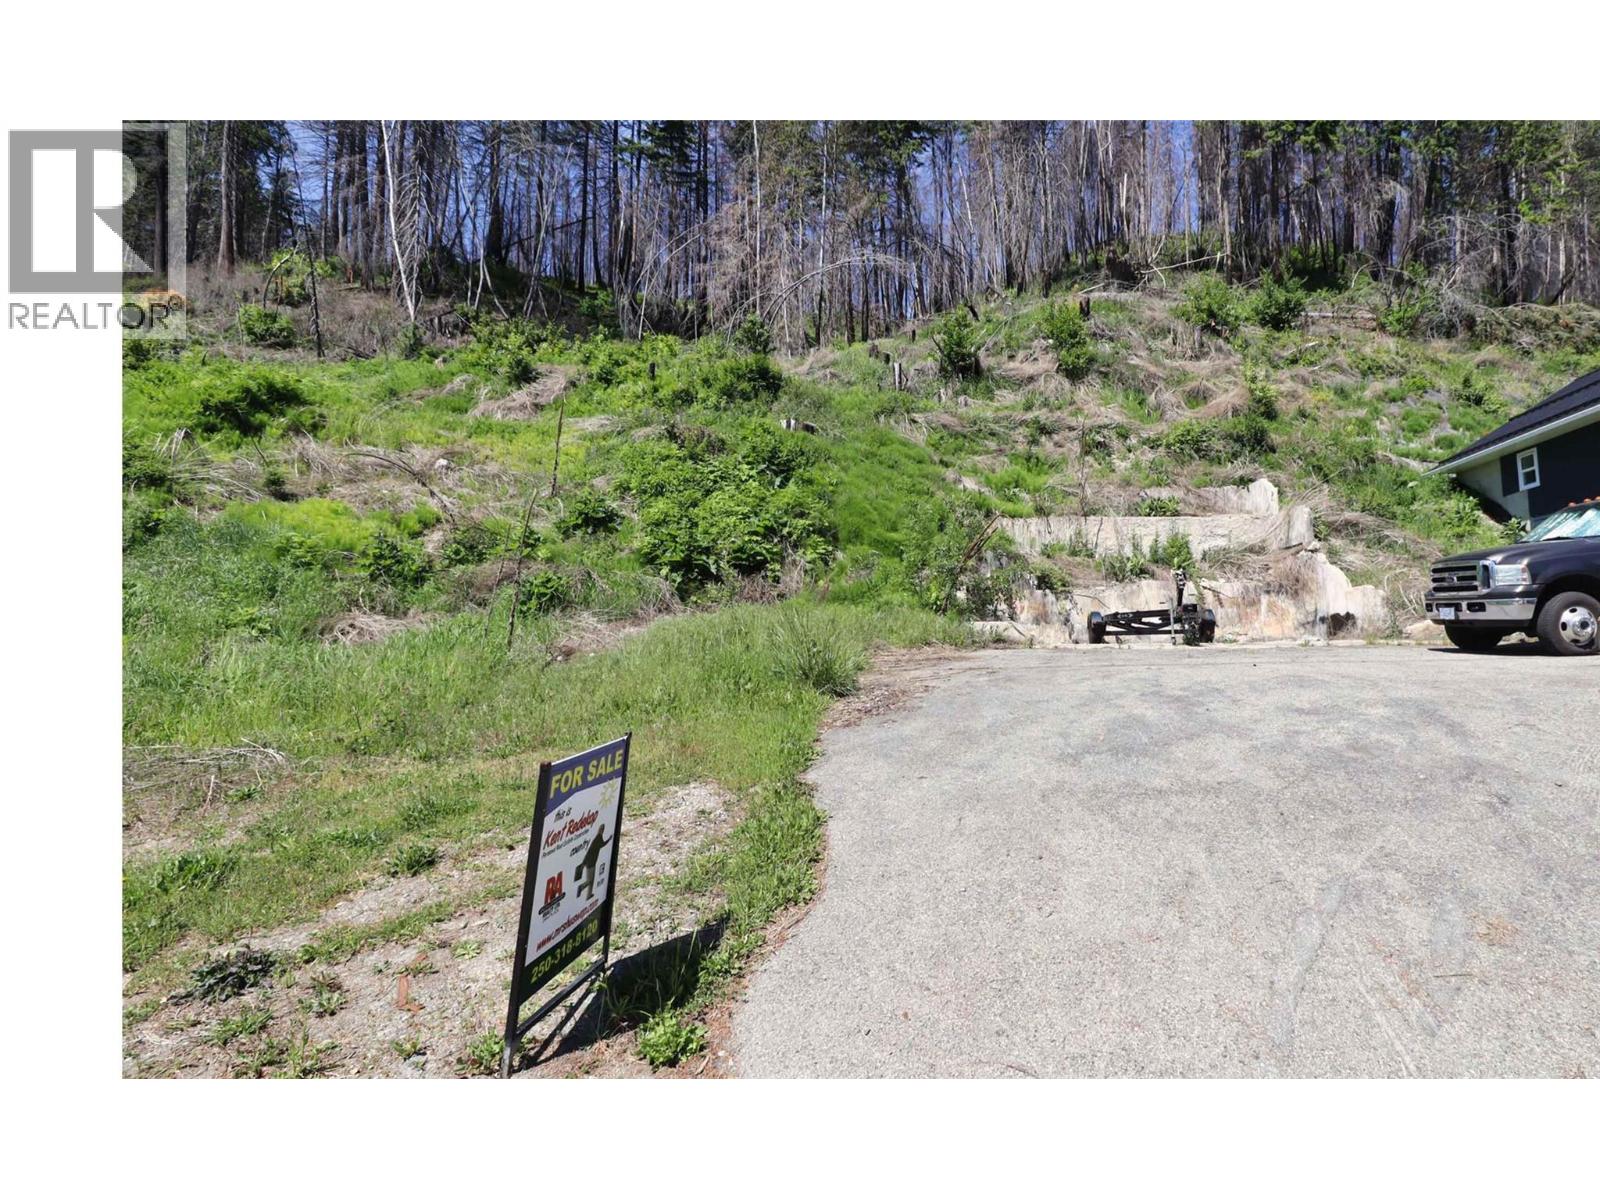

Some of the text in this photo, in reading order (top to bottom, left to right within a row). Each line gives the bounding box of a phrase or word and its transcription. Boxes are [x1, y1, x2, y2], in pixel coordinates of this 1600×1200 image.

[549, 749, 624, 799] FOR SALE
[543, 822, 567, 850] Kent
